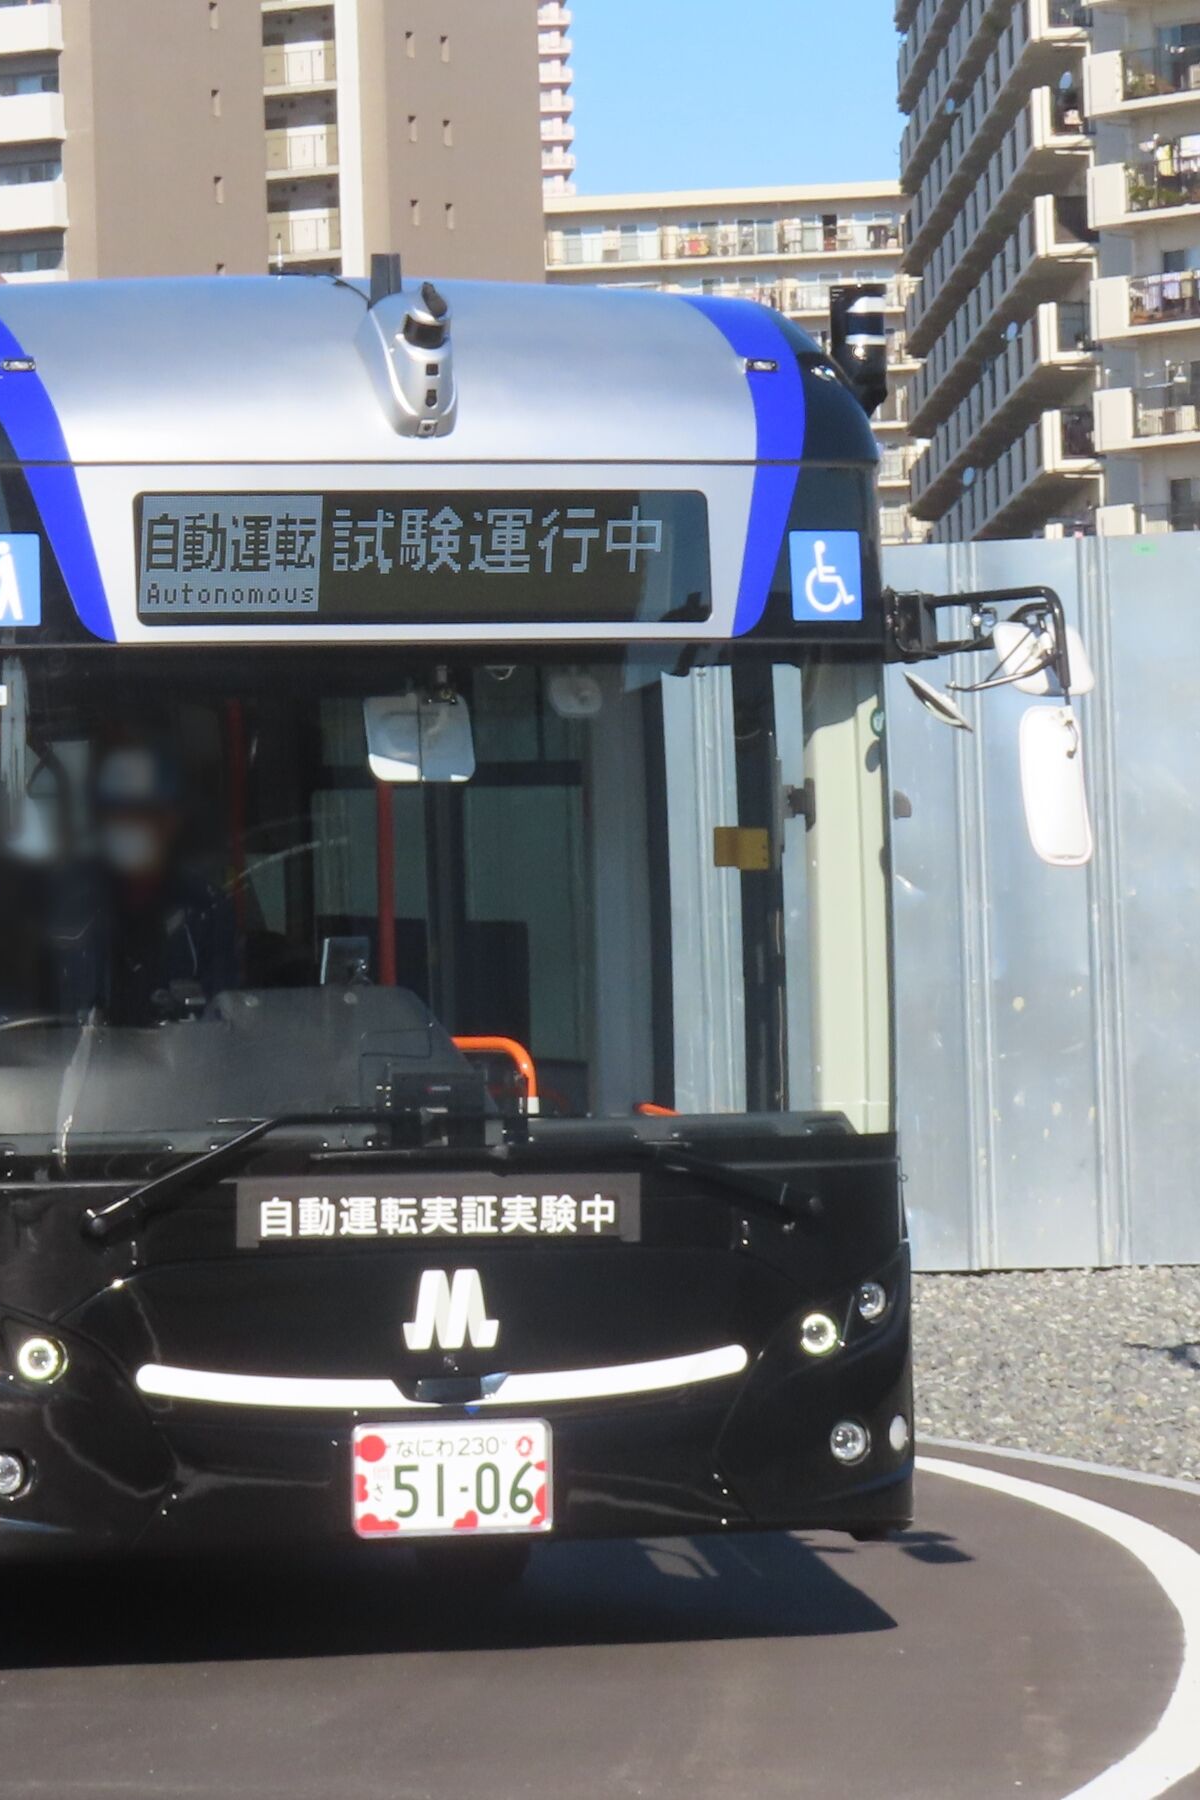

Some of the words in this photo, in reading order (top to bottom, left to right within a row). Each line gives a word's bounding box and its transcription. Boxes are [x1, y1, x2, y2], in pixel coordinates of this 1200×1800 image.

[146, 512, 317, 573] 自動運転
[332, 505, 662, 575] 試験運行中
[147, 583, 315, 604] Autonomous
[259, 1193, 617, 1238] 自動運転実証実験中
[394, 1461, 534, 1519] 51-06
